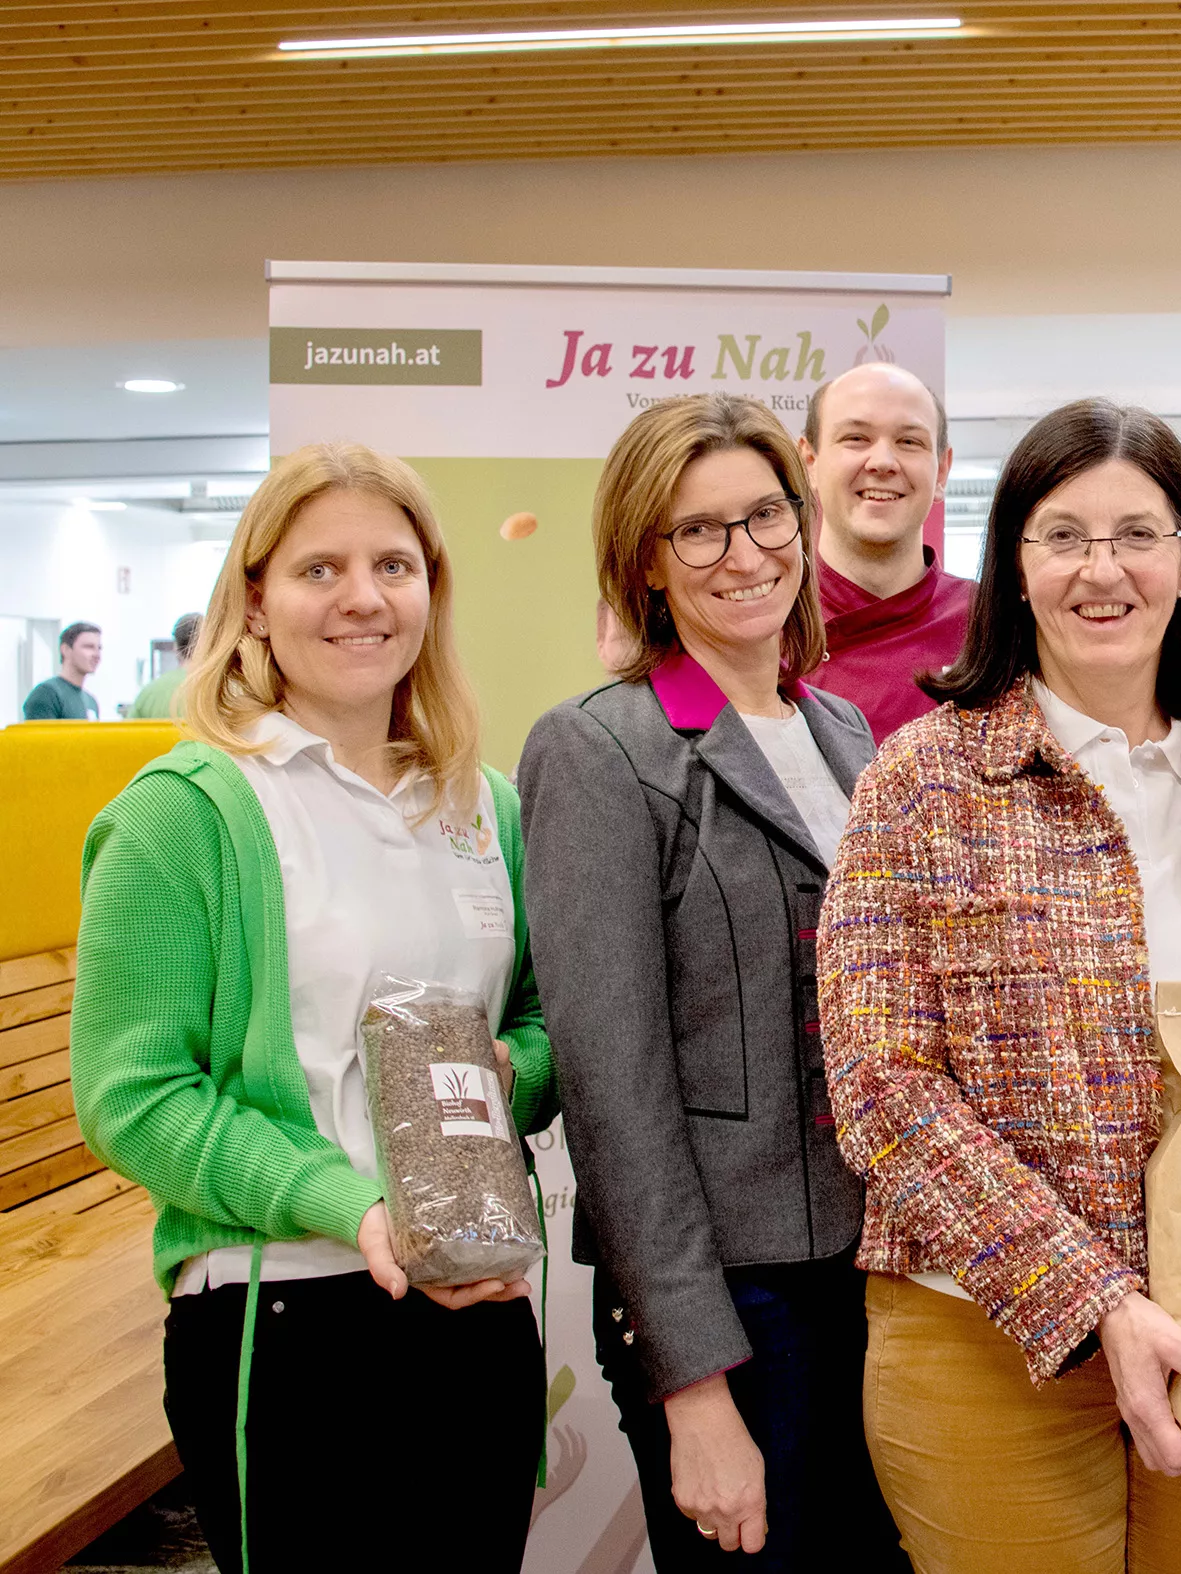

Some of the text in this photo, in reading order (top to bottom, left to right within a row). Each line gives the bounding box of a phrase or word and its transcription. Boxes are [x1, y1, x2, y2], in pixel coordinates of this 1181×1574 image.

[304, 341, 441, 370] jazunah.at
[546, 330, 827, 388] Ja zu Nah
[771, 391, 809, 412] Küc
[439, 820, 470, 840] Ja zu
